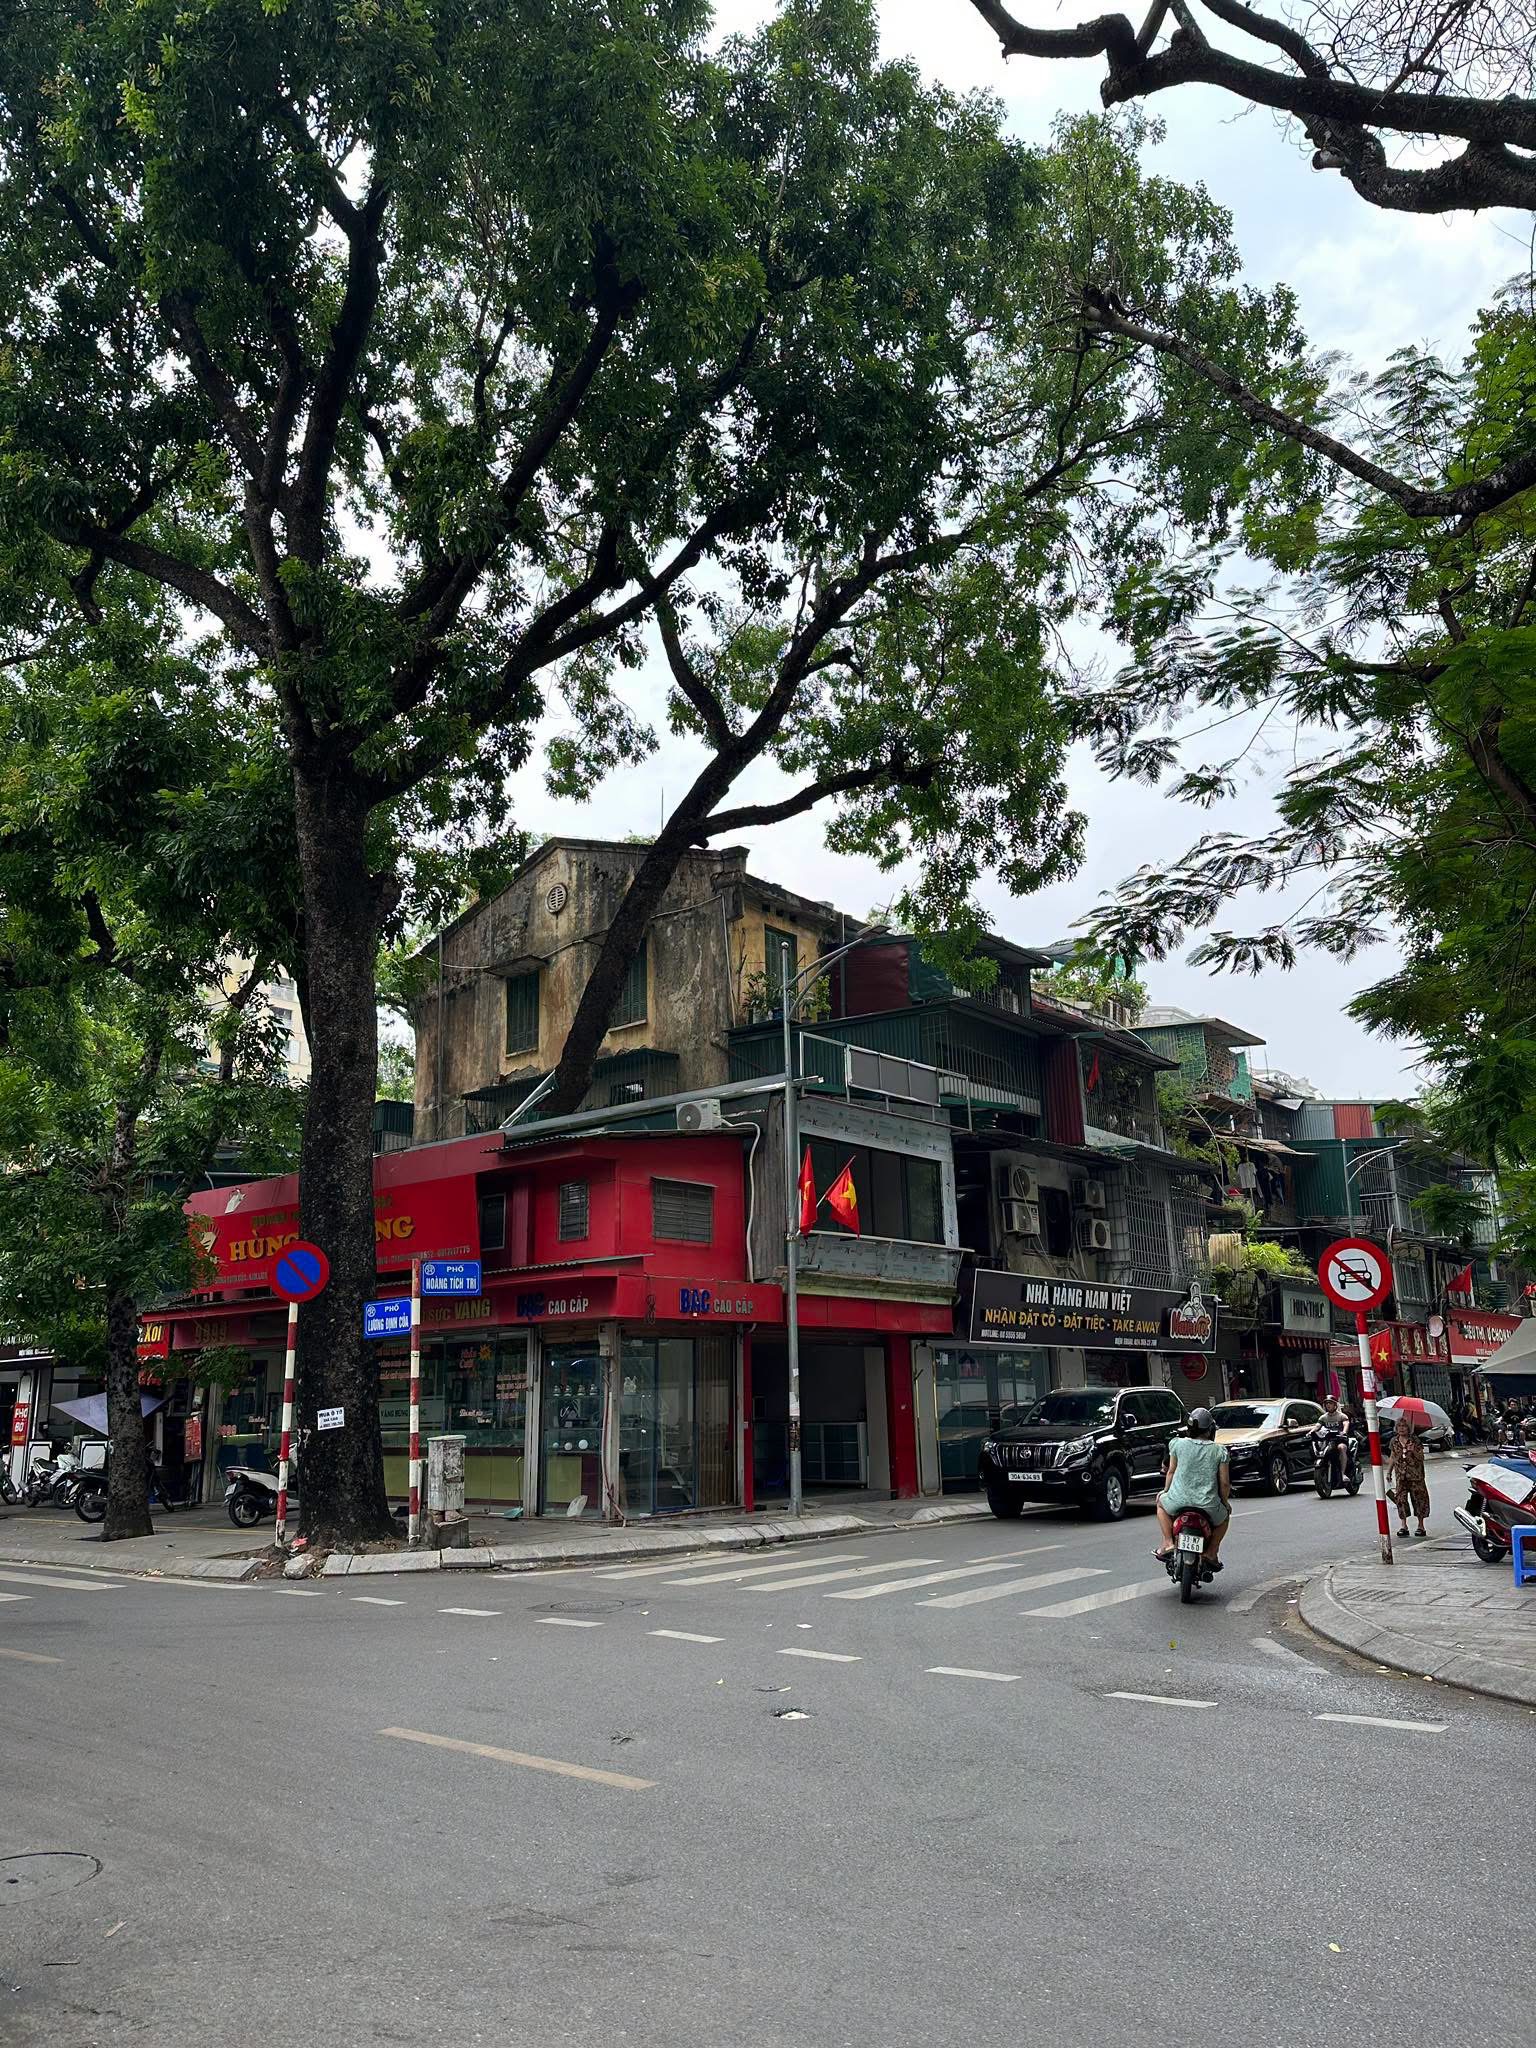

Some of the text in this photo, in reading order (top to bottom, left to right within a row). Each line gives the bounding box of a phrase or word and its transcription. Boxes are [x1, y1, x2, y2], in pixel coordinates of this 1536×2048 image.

[446, 1264, 464, 1273] PHỐ
[426, 1275, 448, 1290] HOÀNG
[450, 1275, 464, 1290] TÍCH
[548, 1299, 567, 1315] CAO
[569, 1291, 589, 1314] CẤP
[713, 1298, 732, 1314] CAO
[1026, 1281, 1132, 1315] NHÀ HÀNG NAM VIỆT
[384, 1302, 400, 1312] PHỐ
[385, 1316, 398, 1331] ĐỊNH
[398, 1312, 409, 1329] CỦA
[985, 1307, 1016, 1327] NHẬN
[1019, 1308, 1040, 1329] ĐẶT
[1063, 1312, 1083, 1332] ĐẶT
[1085, 1313, 1105, 1333] TIỆC
[1112, 1319, 1135, 1332] TAKE
[1136, 1320, 1160, 1334] AWAY
